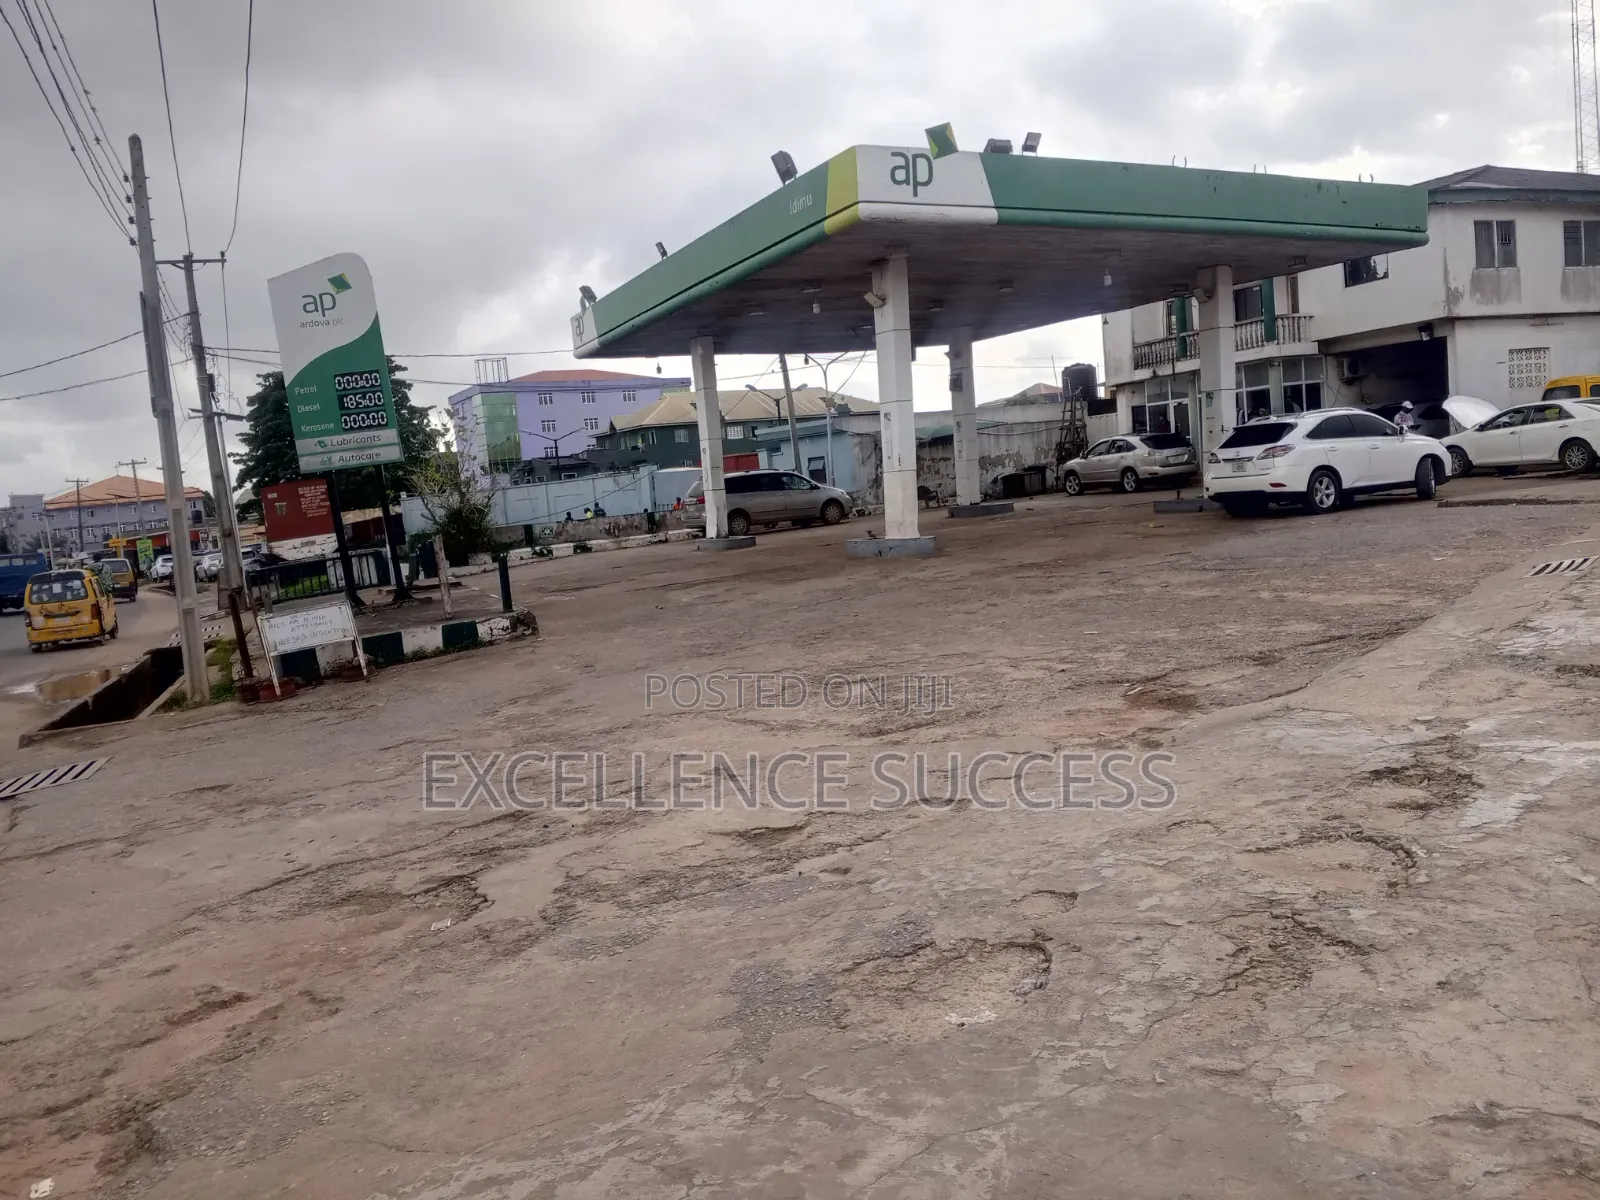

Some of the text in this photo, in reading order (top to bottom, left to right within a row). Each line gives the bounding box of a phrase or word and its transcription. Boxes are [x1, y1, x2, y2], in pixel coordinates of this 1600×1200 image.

[890, 152, 934, 197] ap
[790, 193, 812, 215] Idimu
[302, 292, 336, 317] ap
[300, 317, 344, 328] ardova plc
[575, 315, 584, 342] ap
[294, 385, 317, 395] Petrol
[297, 402, 320, 413] Diesel
[301, 422, 335, 432] Kerosene
[330, 434, 382, 447] Lubricants
[338, 452, 381, 463] Autocare
